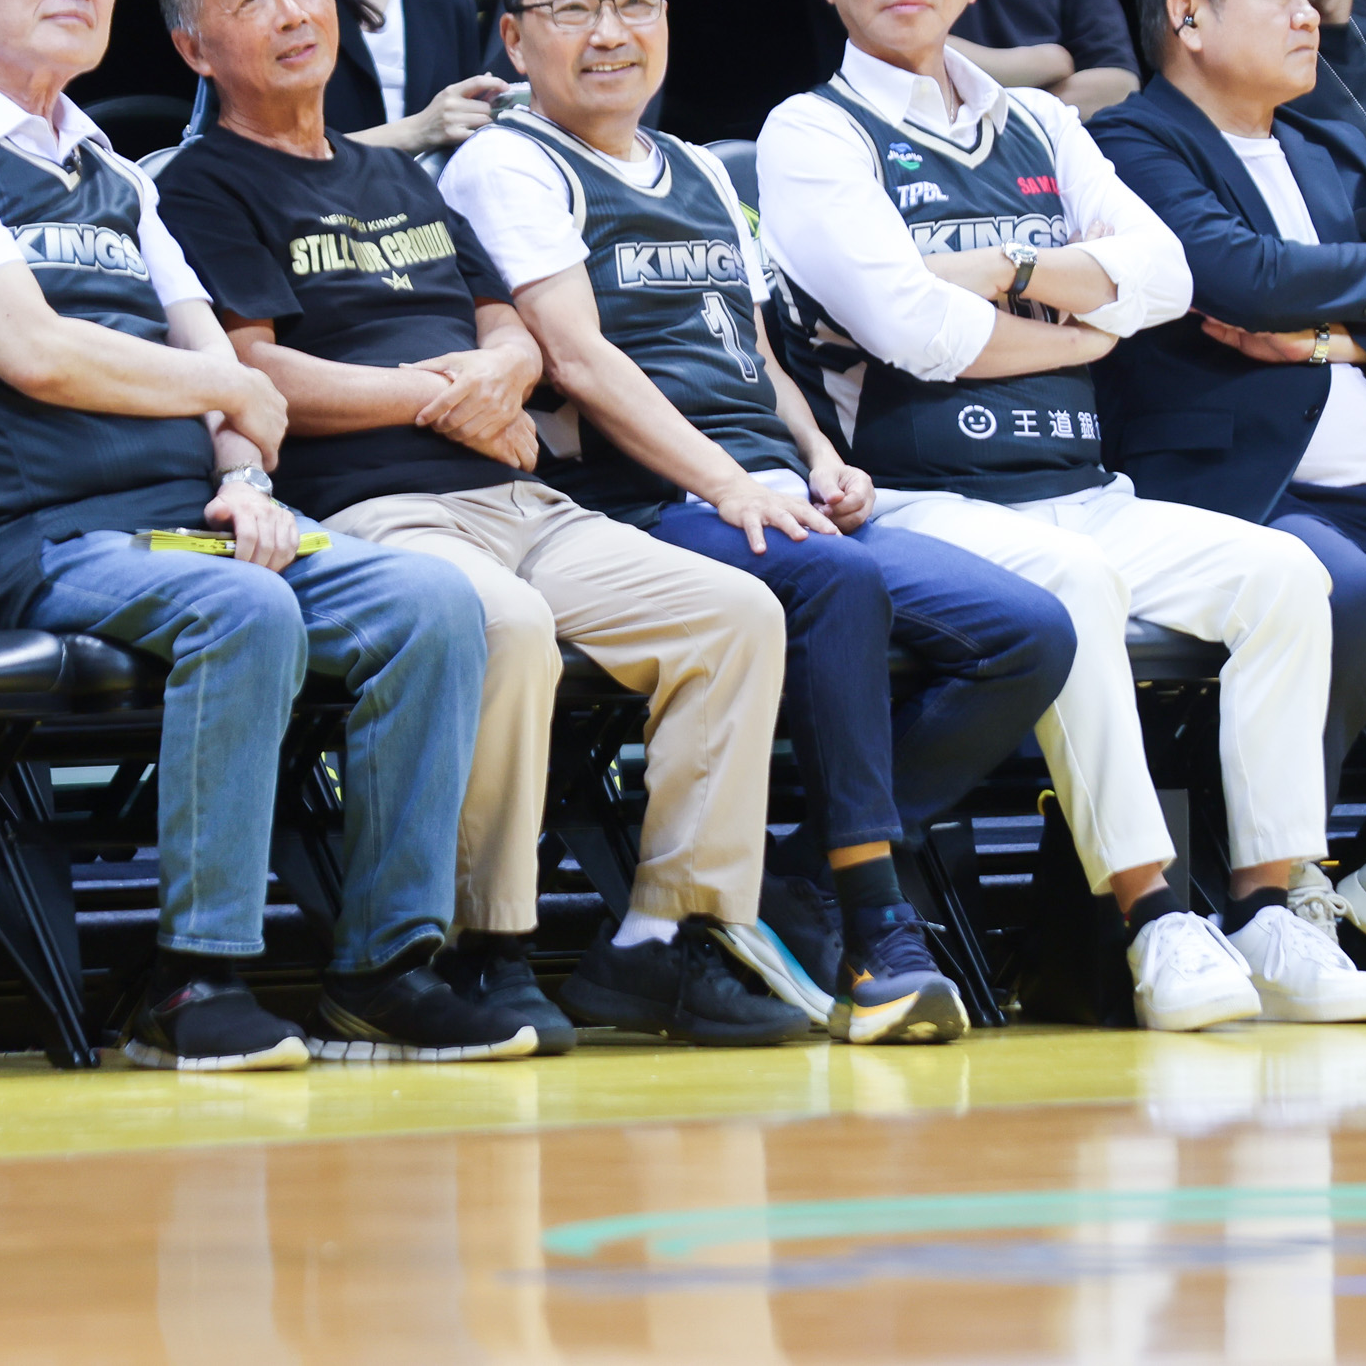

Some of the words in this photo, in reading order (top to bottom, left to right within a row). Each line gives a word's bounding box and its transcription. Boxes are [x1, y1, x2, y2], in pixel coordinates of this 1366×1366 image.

[896, 181, 950, 210] TPBL
[9, 222, 151, 281] KINGS
[289, 233, 357, 276] STILL
[701, 291, 759, 383] 1
